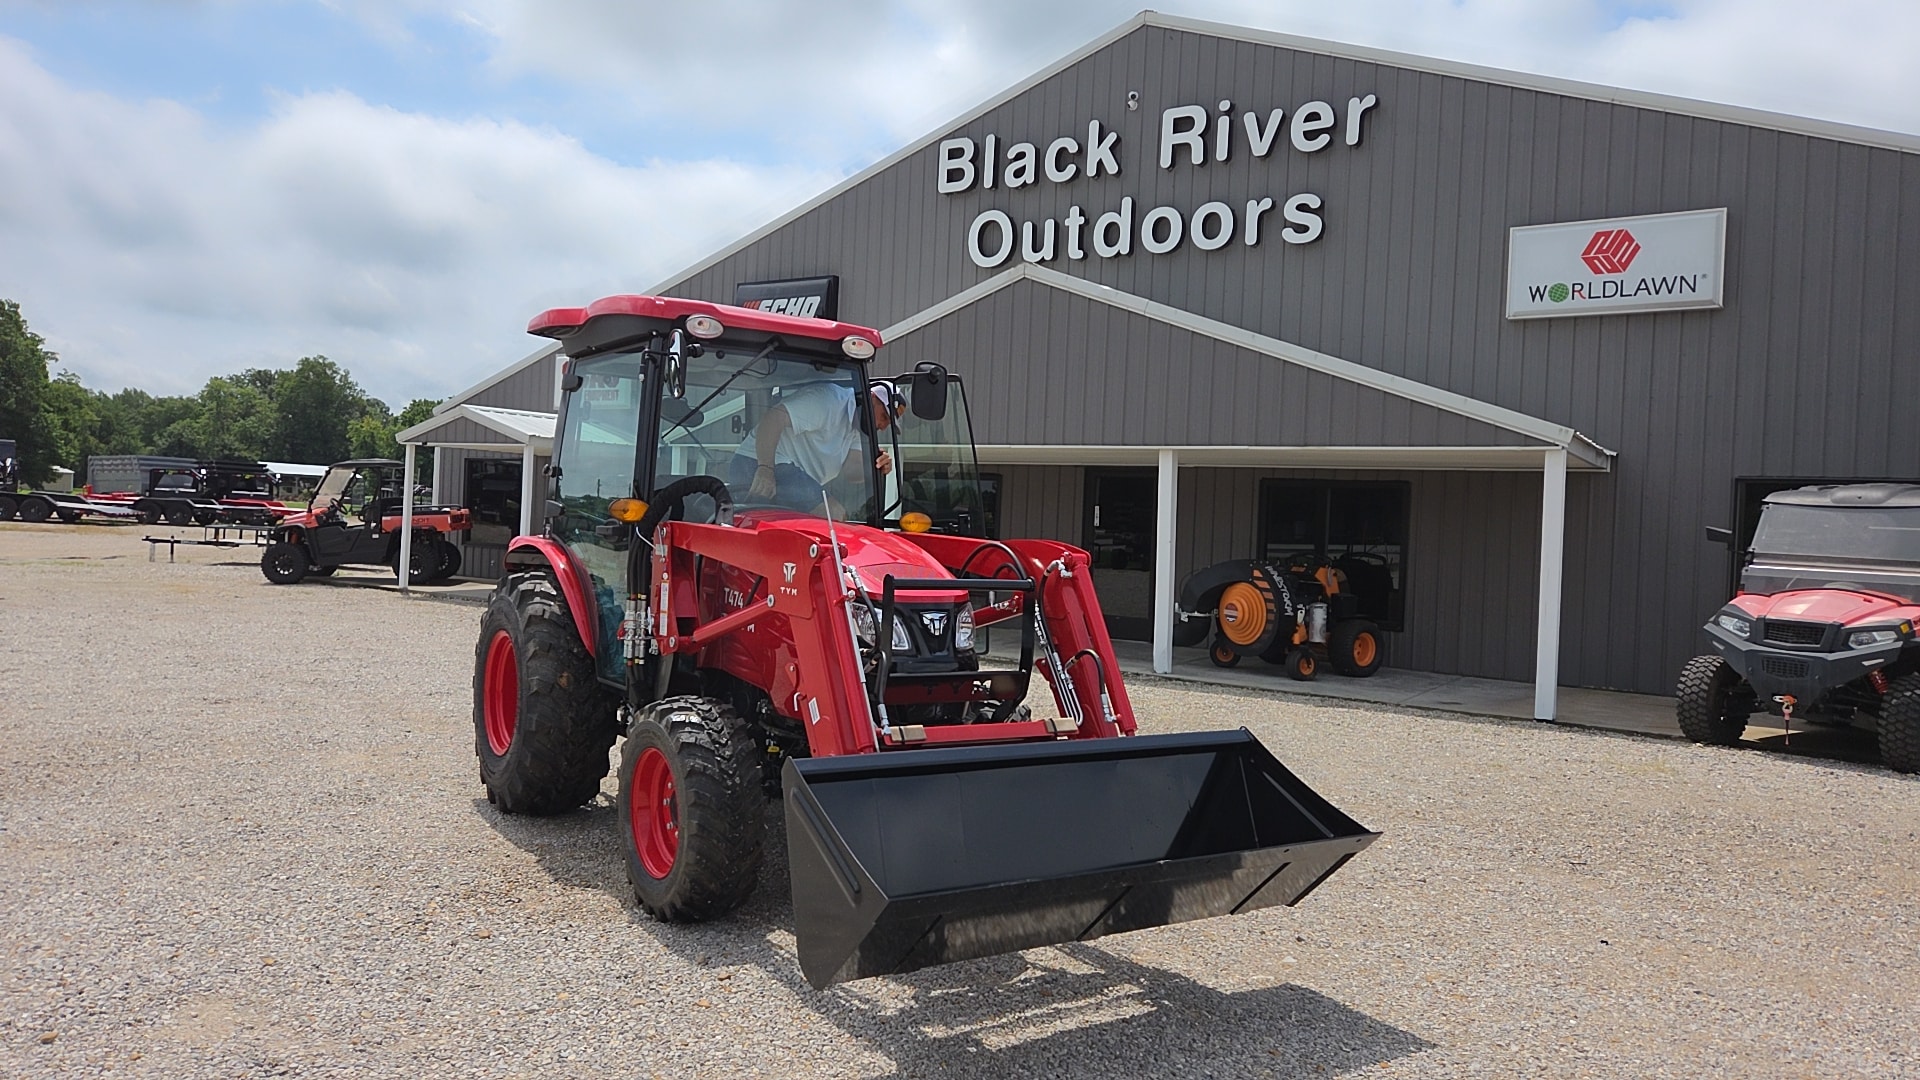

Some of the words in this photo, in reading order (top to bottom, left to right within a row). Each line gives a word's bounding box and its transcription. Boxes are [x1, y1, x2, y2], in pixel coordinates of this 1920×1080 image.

[937, 119, 1119, 194] Black
[1159, 94, 1377, 169] River
[967, 192, 1324, 268] Outdoors
[1528, 274, 1698, 303] WORLDLAWN
[758, 295, 821, 318] ECHO
[723, 587, 744, 609] T474
[779, 586, 798, 596] TYM
